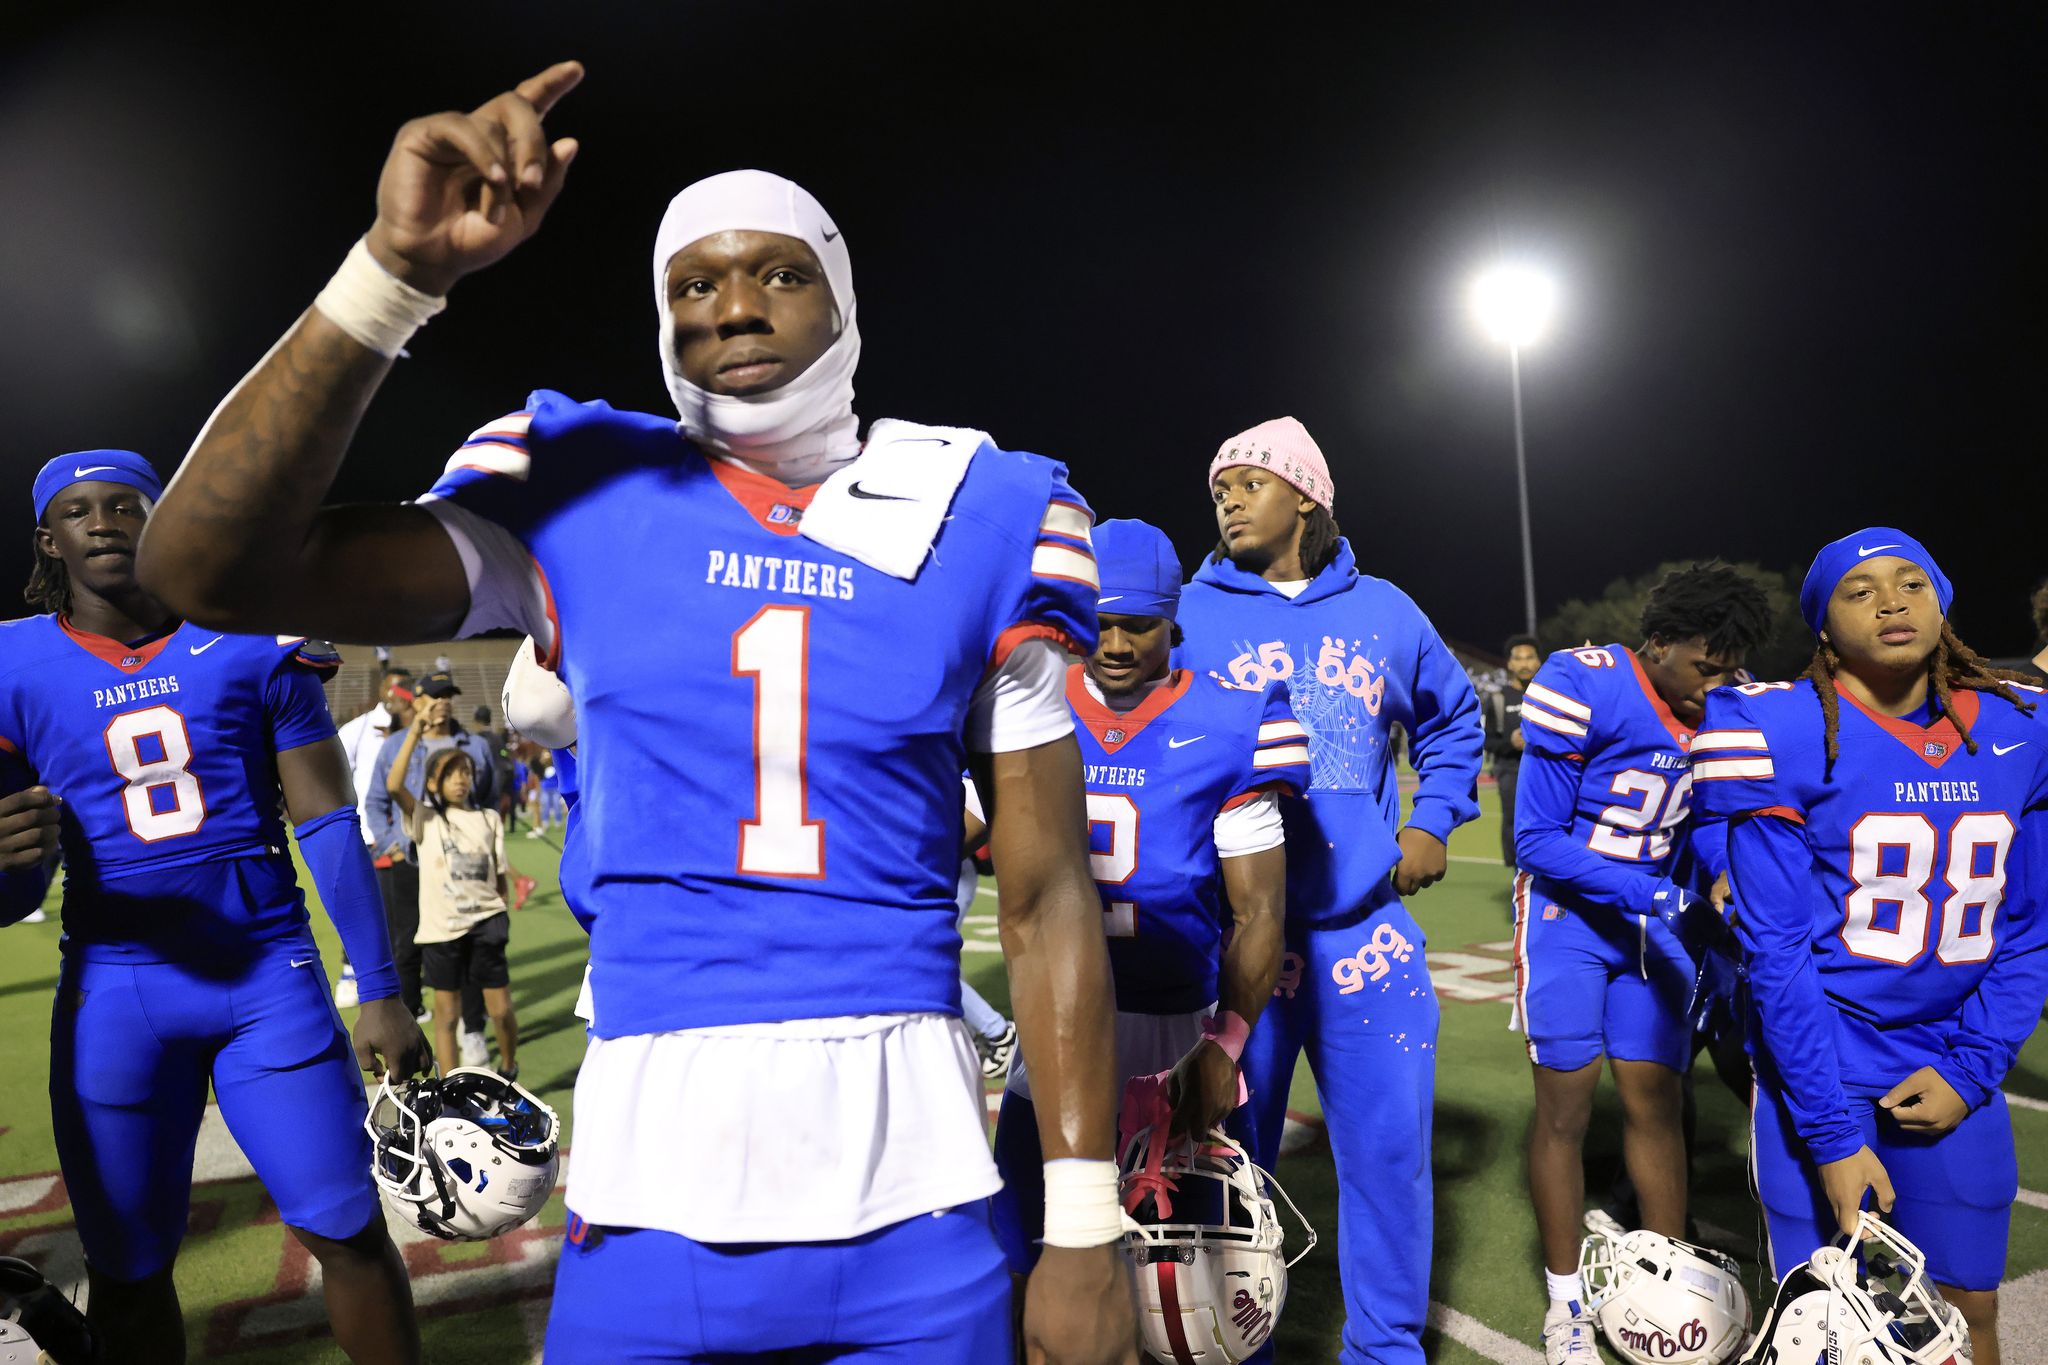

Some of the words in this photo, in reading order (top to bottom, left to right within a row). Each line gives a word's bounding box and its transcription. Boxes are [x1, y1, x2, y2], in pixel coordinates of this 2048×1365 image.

[705, 549, 855, 601] PANTHERS
[93, 675, 180, 709] PANTHERS
[731, 604, 826, 880] 1
[103, 703, 208, 844] 8
[1083, 764, 1146, 787] NTHERS
[1893, 780, 1981, 803] PANTHERS
[1838, 810, 2017, 967] 88
